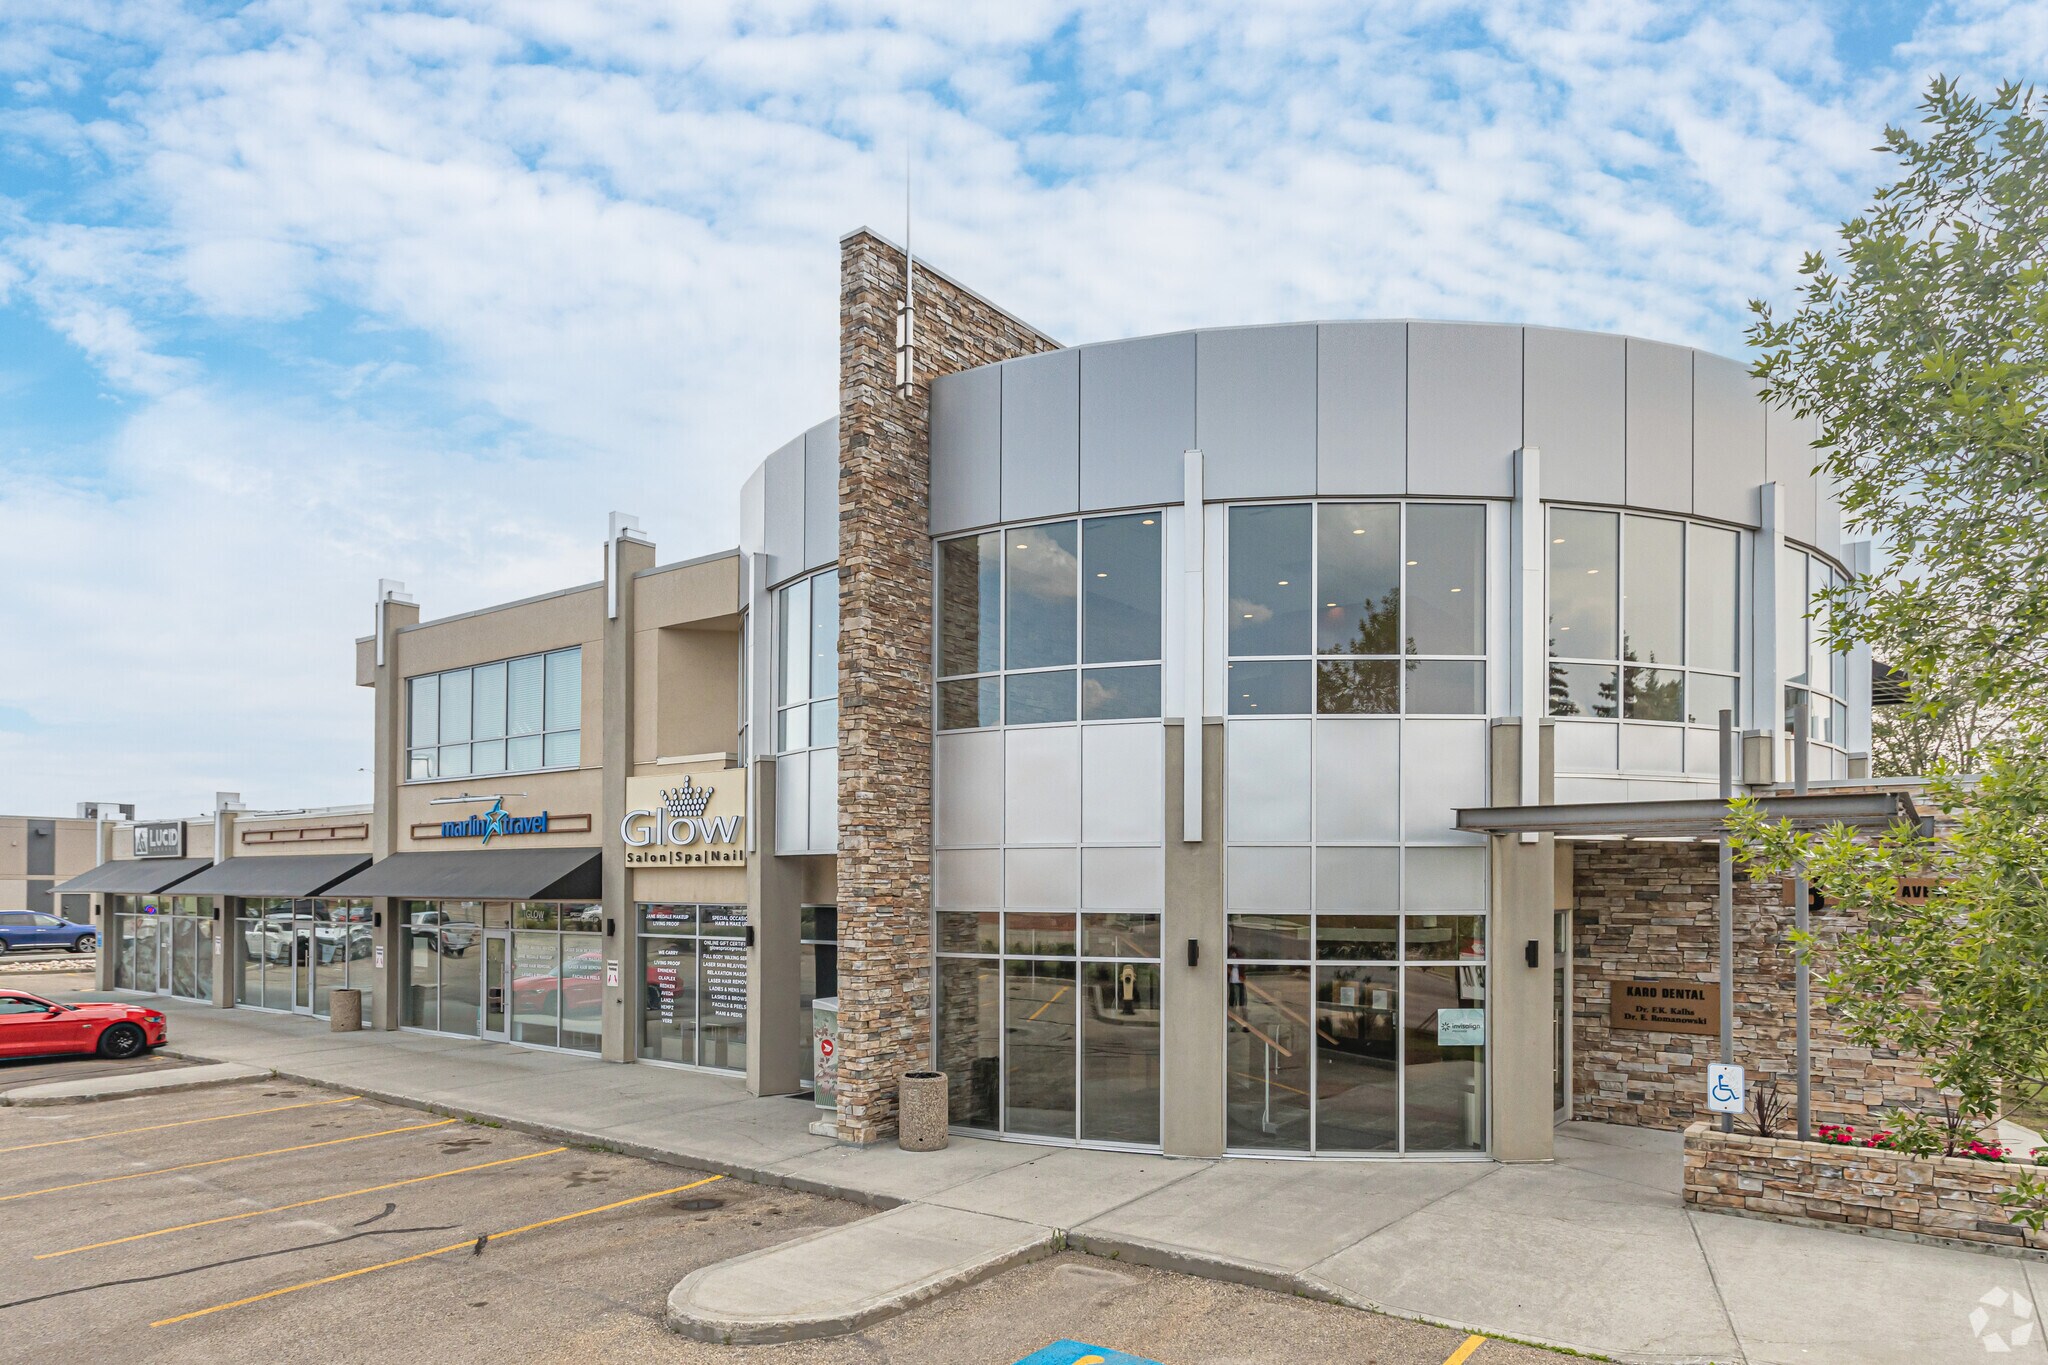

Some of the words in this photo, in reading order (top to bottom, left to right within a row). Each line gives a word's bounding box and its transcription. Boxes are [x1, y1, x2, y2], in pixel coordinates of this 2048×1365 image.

[441, 815, 487, 838] marlin
[502, 811, 548, 834] travel
[620, 807, 744, 847] Glow
[150, 828, 178, 846] LUCID
[526, 909, 544, 919] GLOW
[1626, 986, 1657, 998] KARO
[1662, 988, 1705, 1000] DENTAL
[1635, 1005, 1649, 1013] Dr.
[1651, 1014, 1707, 1024] Romanowski
[1452, 1022, 1480, 1030] invisalign
